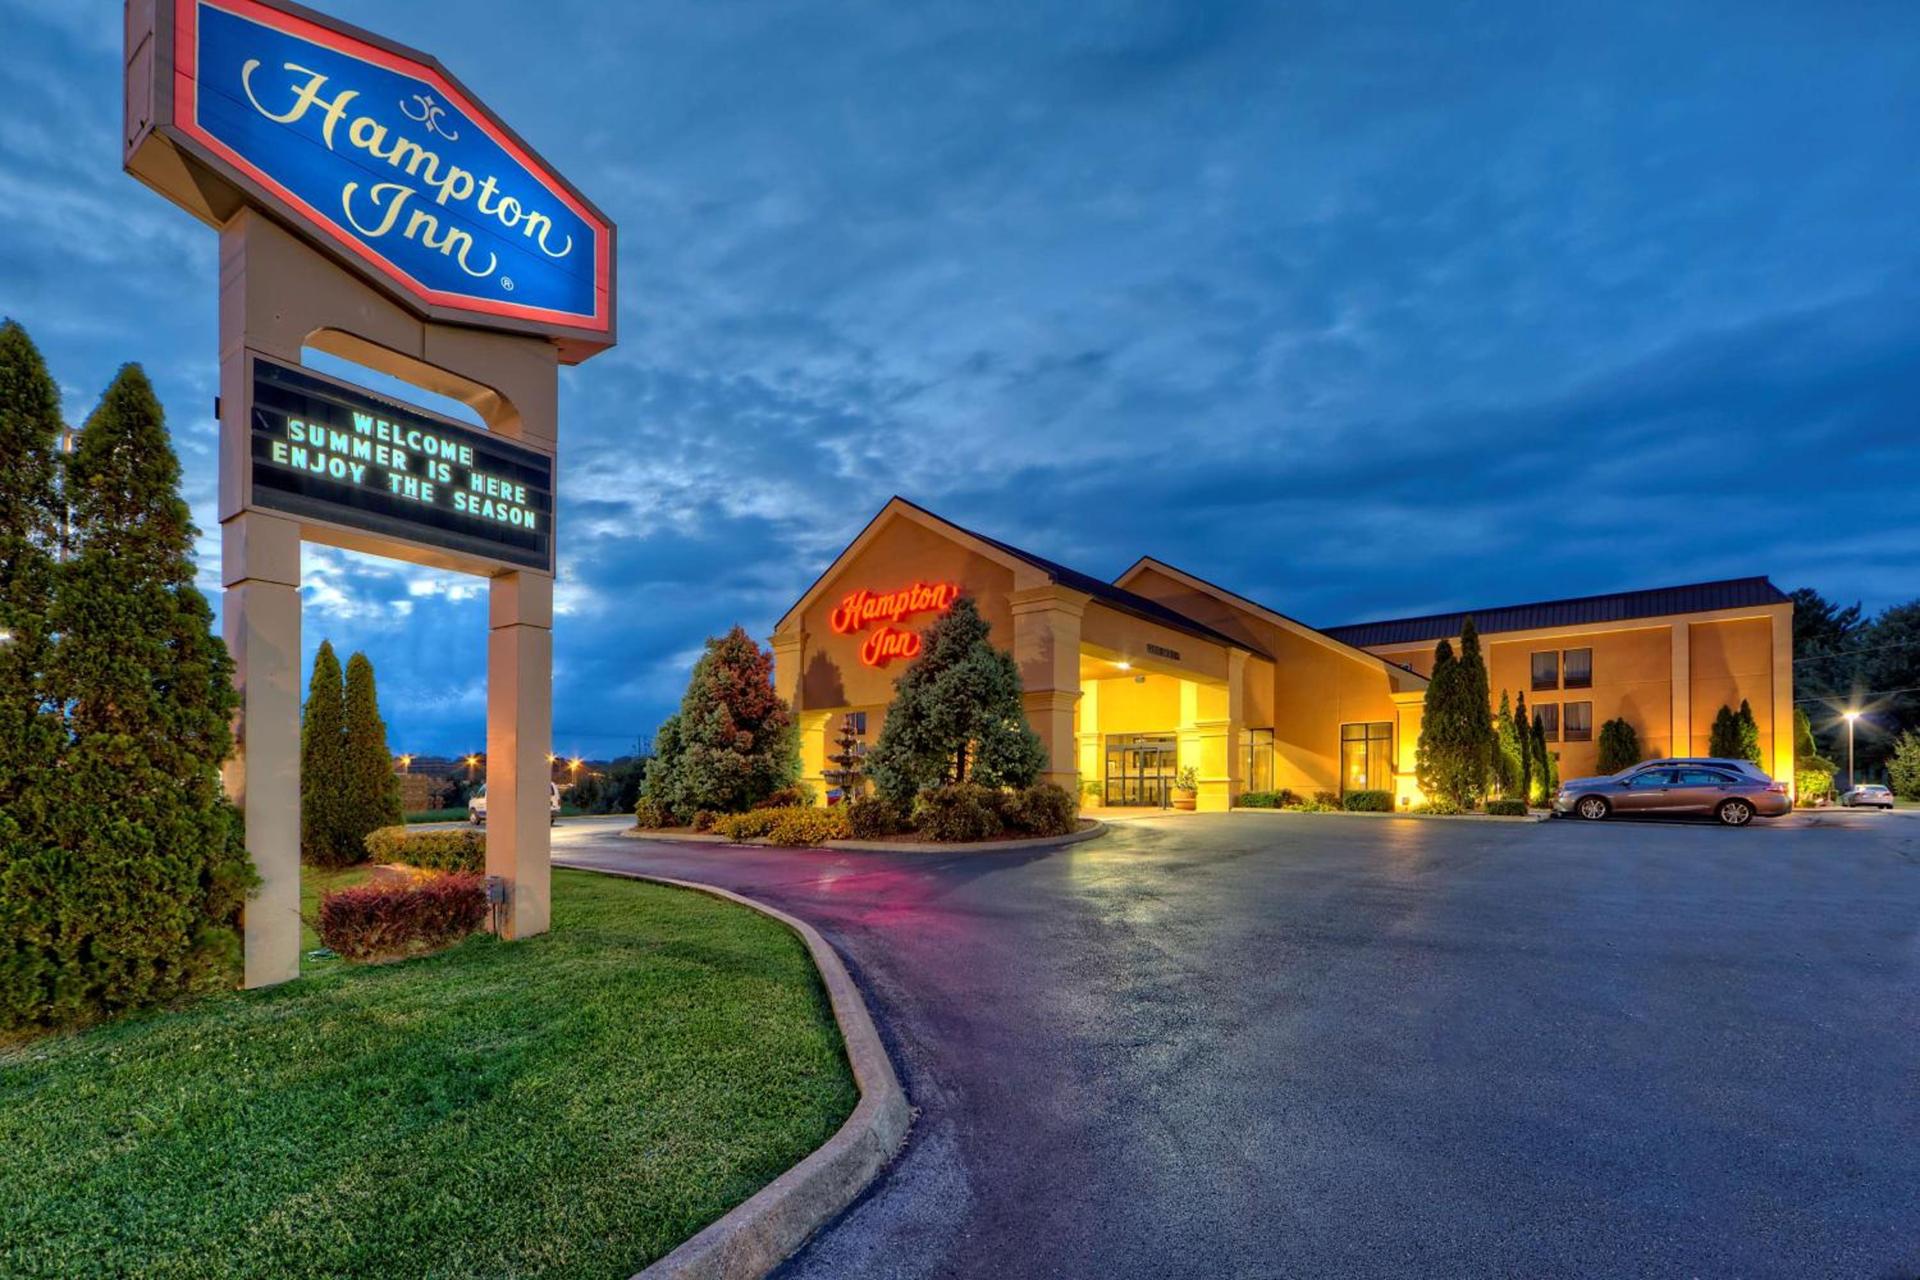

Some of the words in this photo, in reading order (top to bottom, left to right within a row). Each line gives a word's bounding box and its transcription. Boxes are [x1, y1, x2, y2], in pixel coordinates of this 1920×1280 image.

[242, 59, 572, 257] Hampton
[342, 182, 497, 277] Inn
[289, 419, 408, 471] SUMMER
[428, 460, 451, 482] IS
[471, 471, 526, 505] HERE
[353, 412, 472, 466] WELCOME
[272, 441, 366, 484] ENJOY
[389, 473, 434, 502] THE
[454, 492, 536, 529] SEASON
[831, 583, 959, 633] Hampton
[862, 626, 921, 665] Inn
